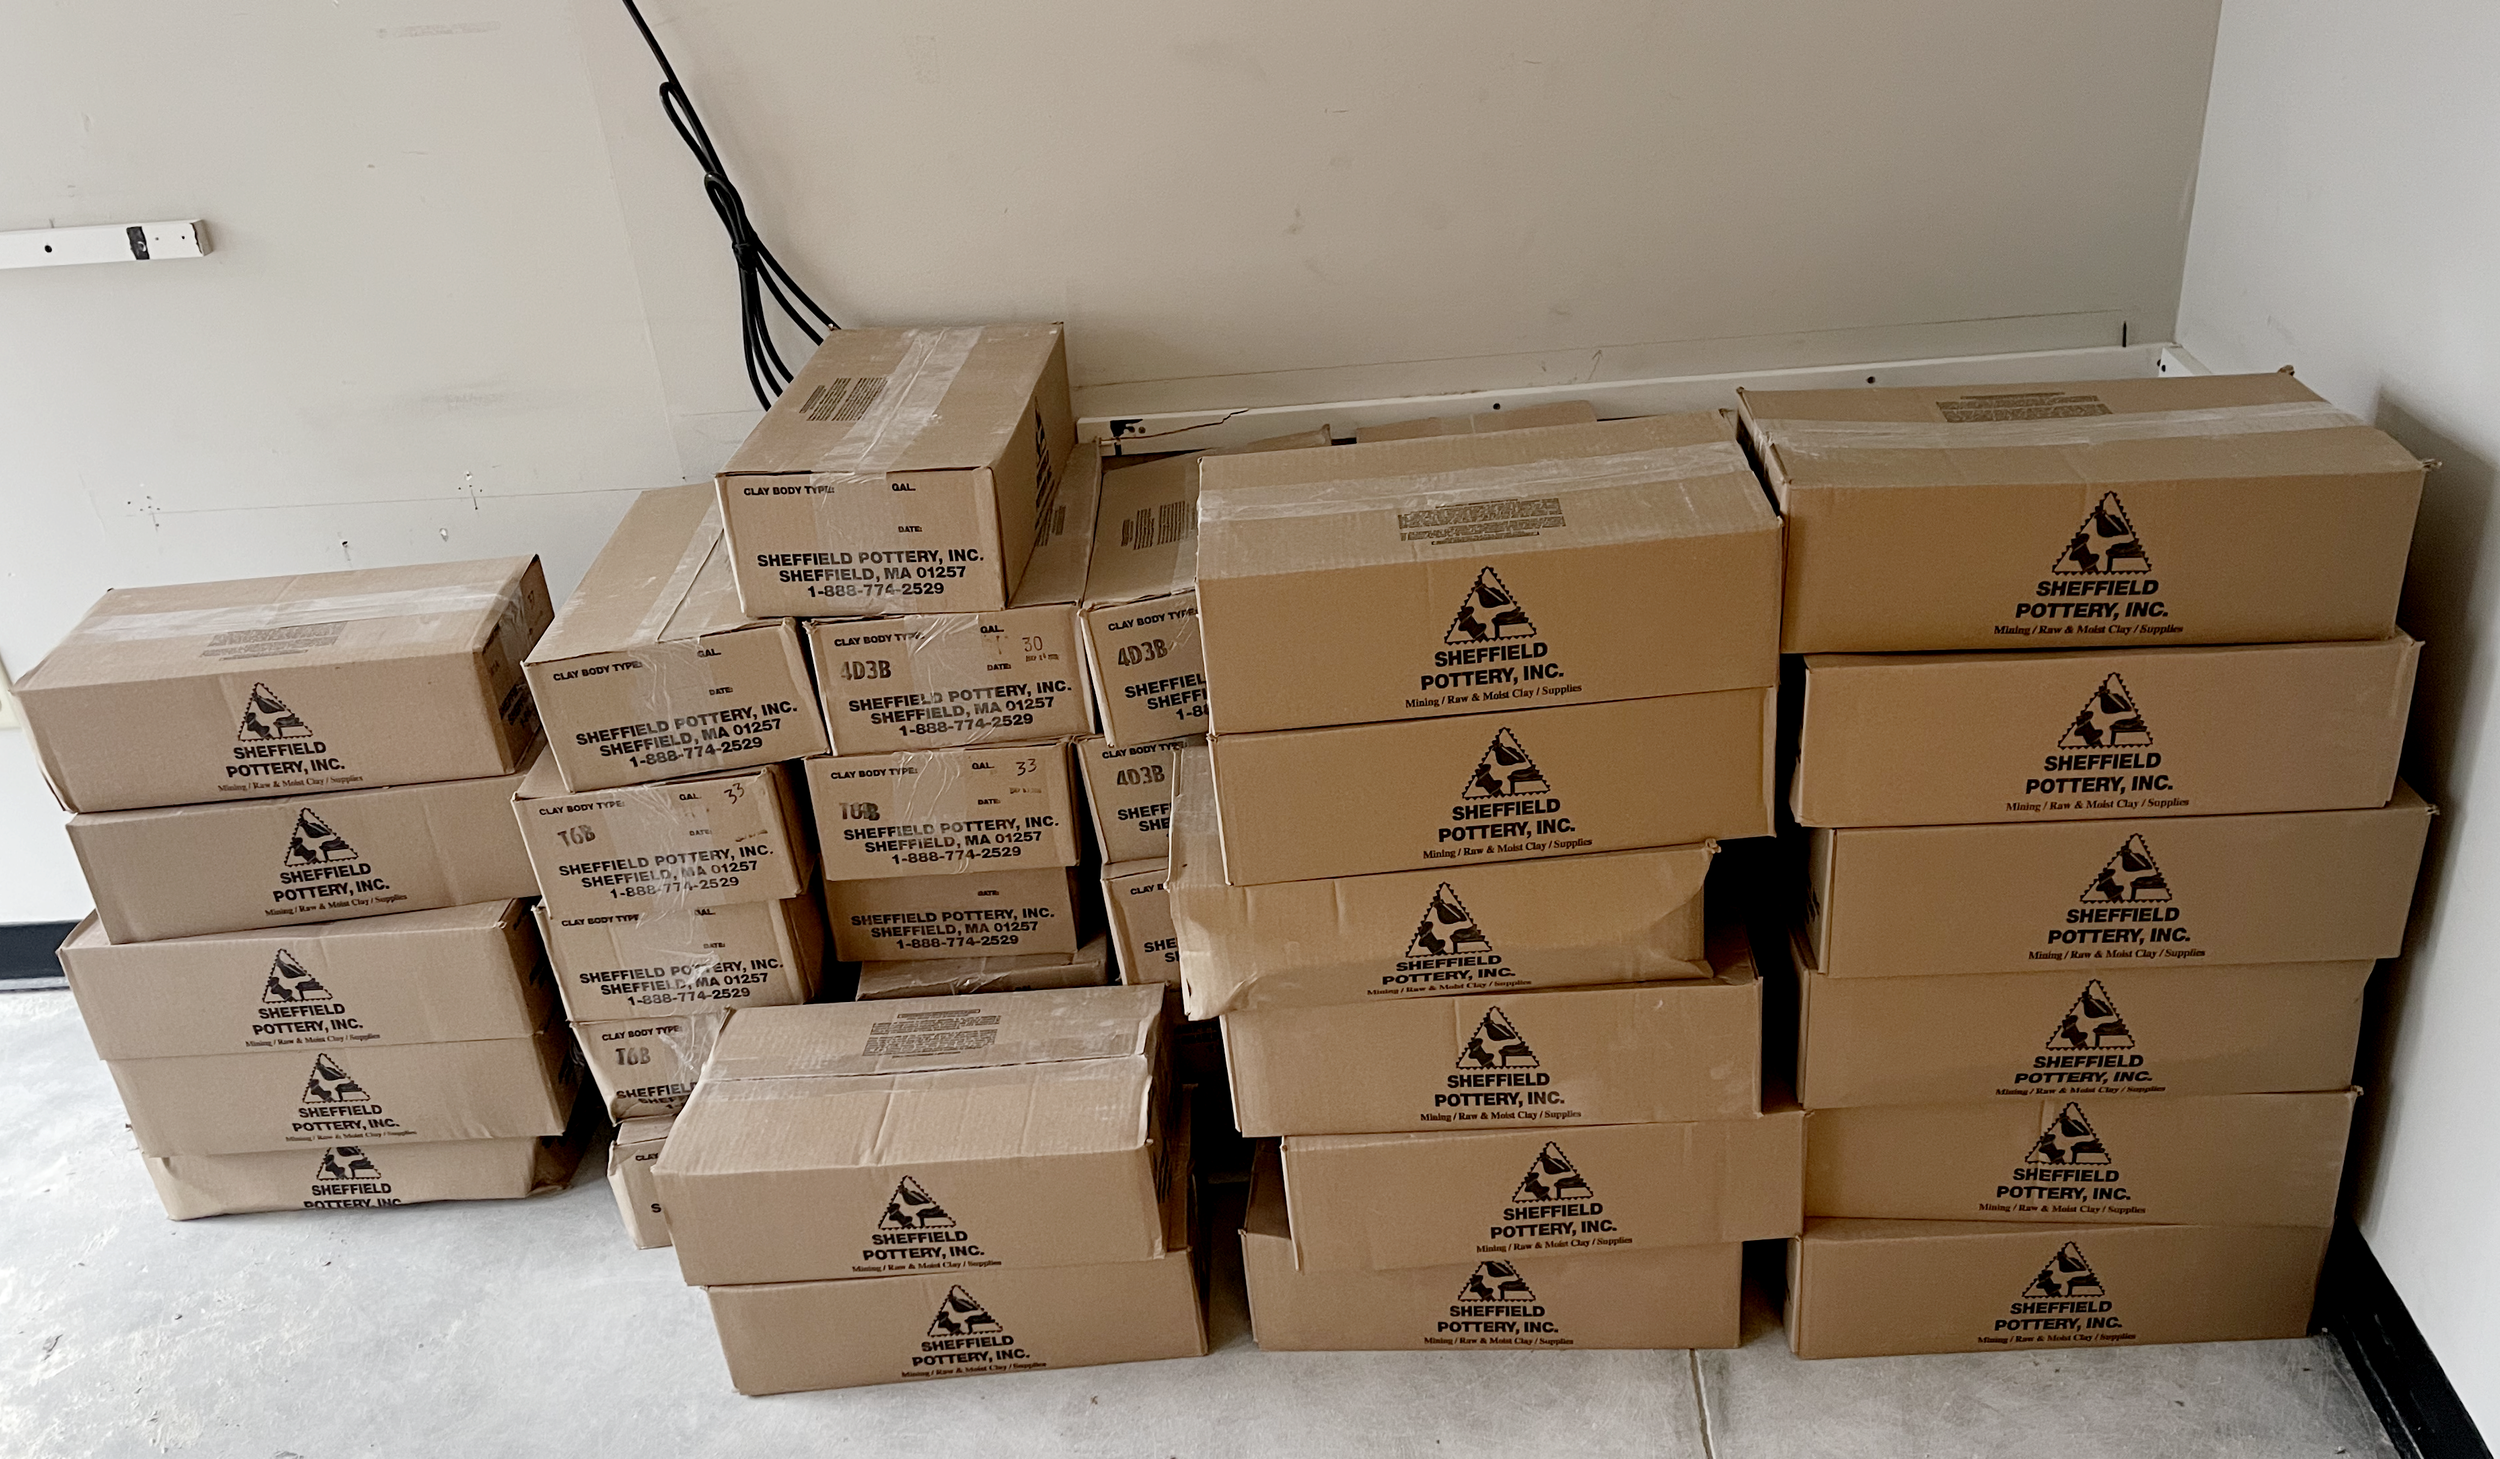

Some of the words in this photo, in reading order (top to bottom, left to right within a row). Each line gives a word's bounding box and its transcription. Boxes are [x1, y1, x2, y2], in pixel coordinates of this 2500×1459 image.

[744, 488, 769, 496] CLAY
[773, 486, 801, 495] BODY
[758, 553, 852, 566] SHEFFIELD
[859, 550, 942, 565] POTTERY,
[948, 549, 984, 562] INC.
[780, 568, 880, 582] SHEFFIELD,
[884, 567, 912, 579] MA
[916, 566, 966, 578] 01257
[808, 582, 944, 597] 1-888-774-2529
[2036, 580, 2159, 596] SHEFFIELD
[2016, 602, 2119, 620] POTTERY,
[2125, 602, 2168, 617] INC.
[1108, 619, 1134, 631] CLAY
[1137, 614, 1165, 626] BODY
[1994, 626, 2030, 636] Mining
[2038, 626, 2062, 634] Raw
[2064, 626, 2073, 634] &
[2077, 625, 2106, 634] Moist
[2108, 625, 2132, 635] Clay
[2140, 624, 2183, 634] Supplies
[834, 637, 860, 646] CLAY
[863, 634, 892, 644] BODY
[1022, 636, 1042, 652] 30
[1435, 642, 1548, 667] SHEFFIELD
[553, 670, 578, 681] CLAY
[582, 665, 609, 676] BODY
[1421, 667, 1518, 690] POTTERY,
[1524, 663, 1564, 680] INC.
[849, 692, 942, 712] SHEFFIELD
[948, 684, 1031, 702] POTTERY,
[1037, 680, 1072, 694] INC.
[1406, 698, 1440, 708] Mining
[1448, 696, 1468, 704] Raw
[1472, 693, 1480, 701] &
[1483, 691, 1509, 701] Moist
[1512, 689, 1534, 698] Clay
[1542, 684, 1582, 696] Supplies
[871, 706, 970, 724] SHEFFIELD,
[974, 702, 1002, 714] MA
[1006, 696, 1054, 711] 01257
[576, 721, 669, 745] SHEFFIELD
[674, 707, 757, 729] POTTERY,
[761, 702, 797, 720] INC.
[899, 713, 1033, 736] 1-888-774-2529
[600, 733, 698, 756] SHEFFIELD,
[702, 726, 730, 740] MA
[733, 718, 781, 735] 01257
[234, 742, 326, 759] SHEFFIELD
[630, 737, 762, 767] 1-888-774-2529
[226, 761, 308, 778] POTTERY,
[310, 758, 345, 771] INC.
[1016, 758, 1037, 776] 33
[2044, 753, 2161, 771] SHEFFIELD
[2026, 776, 2126, 794] POTTERY,
[2132, 775, 2173, 791] INC.
[724, 783, 744, 804] 33
[539, 806, 563, 815] CLAY
[566, 803, 593, 812] BODY
[1452, 799, 1560, 820] SHEFFIELD
[844, 824, 933, 840] SHEFFIELD
[940, 818, 1020, 833] POTTERY,
[1025, 816, 1058, 828] INC.
[1439, 822, 1531, 842] POTTERY,
[1537, 818, 1575, 834] INC.
[865, 837, 960, 852] SHEFFIELD,
[965, 834, 991, 846] MA
[995, 831, 1042, 843] 01257
[1424, 850, 1456, 859] Mining
[1464, 848, 1483, 856] Raw
[1498, 844, 1523, 853] Moist
[1526, 842, 1546, 851] Clay
[1554, 838, 1592, 849] Supplies
[559, 858, 648, 876] SHEFFIELD
[655, 848, 734, 866] POTTERY,
[739, 845, 773, 857] INC.
[892, 846, 1021, 864] 1-888-774-2529
[280, 863, 371, 884] SHEFFIELD
[582, 870, 677, 888] SHEFFIELD,
[712, 860, 757, 873] 01257
[273, 882, 354, 902] POTTERY,
[356, 879, 390, 892] INC.
[610, 877, 739, 898] 1-888-774-2529
[850, 912, 937, 927] SHEFFIELD
[942, 909, 1017, 922] POTTERY,
[1022, 908, 1054, 918] INC.
[2066, 908, 2180, 923] SHEFFIELD
[871, 924, 961, 938] SHEFFIELD,
[965, 923, 990, 934] MA
[994, 921, 1038, 932] 01257
[2048, 928, 2144, 945] POTTERY,
[2150, 928, 2190, 942] INC.
[896, 935, 1018, 949] 1-888-774-2529
[1396, 956, 1502, 971] SHEFFIELD
[1382, 970, 1472, 985] POTTERY,
[1478, 968, 1516, 978] INC.
[258, 1004, 345, 1019] SHEFFIELD
[252, 1020, 328, 1035] POTTERY,
[330, 1018, 363, 1030] INC.
[2033, 1055, 2144, 1068] SHEFFIELD
[1448, 1073, 1550, 1088] SHEFFIELD
[2014, 1072, 2108, 1084] POTTERY,
[2113, 1071, 2152, 1082] INC.
[1435, 1092, 1523, 1108] POTTERY,
[1528, 1091, 1564, 1104] INC.
[299, 1105, 382, 1118] SHEFFIELD
[292, 1120, 366, 1132] POTTERY,
[368, 1119, 400, 1128] INC.
[2013, 1168, 2119, 1182] SHEFFIELD
[312, 1183, 391, 1196] SHEFFIELD
[1997, 1186, 2087, 1202] POTTERY,
[2093, 1188, 2131, 1200] INC.
[1503, 1203, 1603, 1220] SHEFFIELD
[872, 1231, 968, 1245] SHEFFIELD
[1491, 1222, 1576, 1239] POTTERY,
[1581, 1220, 1617, 1233] INC.
[863, 1247, 946, 1260] POTTERY,
[949, 1246, 984, 1256] INC.
[1450, 1306, 1545, 1317] SHEFFIELD
[2010, 1301, 2112, 1314] SHEFFIELD
[1438, 1322, 1520, 1335] POTTERY,
[1524, 1322, 1558, 1333] INC.
[1994, 1318, 2081, 1332] POTTERY,
[2086, 1317, 2122, 1328] INC.
[922, 1336, 1014, 1352] SHEFFIELD
[1424, 1337, 1453, 1345] Mining
[1540, 1338, 1573, 1346] Supplies
[912, 1352, 992, 1366] POTTERY,
[996, 1349, 1030, 1360] INC.
